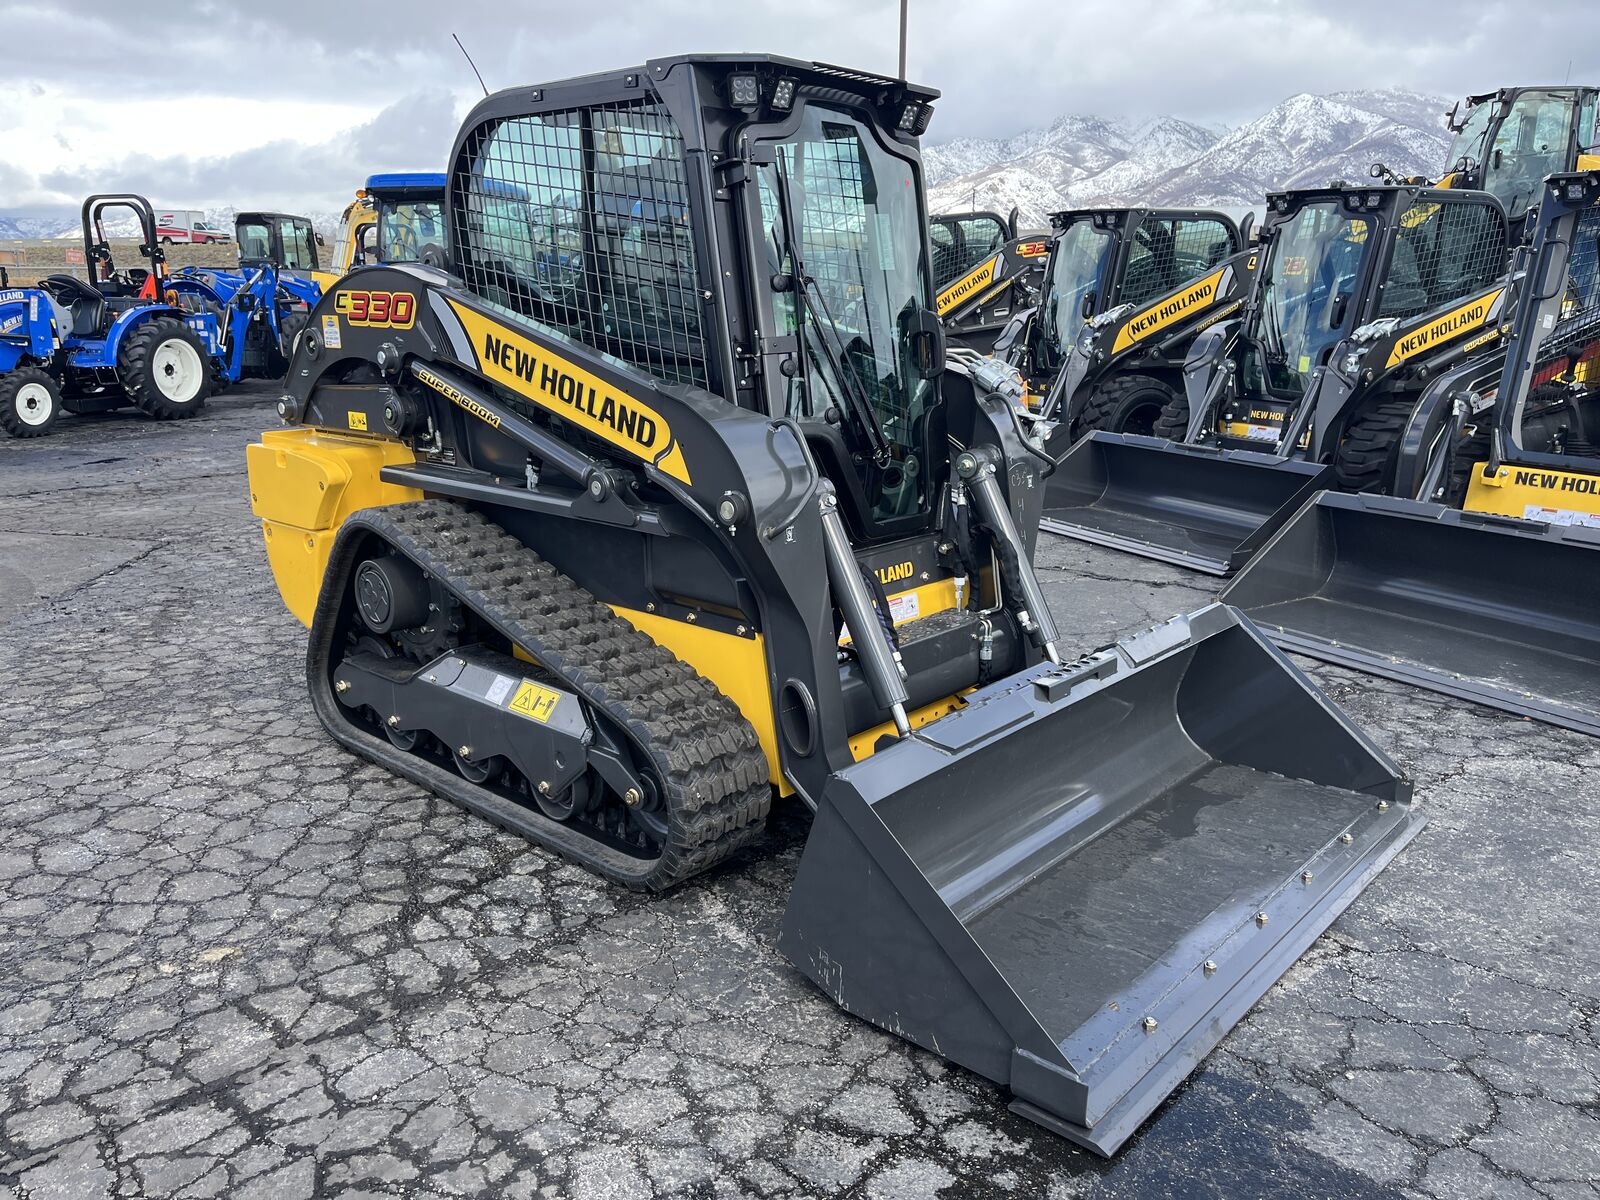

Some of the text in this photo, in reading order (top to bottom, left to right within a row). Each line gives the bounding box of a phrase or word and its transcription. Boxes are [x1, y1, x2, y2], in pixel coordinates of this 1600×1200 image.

[951, 269, 990, 300] HOLLAND
[335, 290, 416, 329] C330
[1131, 284, 1212, 335] NEW HOLLAND
[1401, 305, 1483, 355] NEW HOLLAND
[419, 369, 501, 428] SUPER BOOM
[485, 333, 656, 448] NEW HOLLAND
[1250, 410, 1268, 419] NEW
[1515, 471, 1600, 495] NEW HOL
[875, 561, 914, 585] LAND
